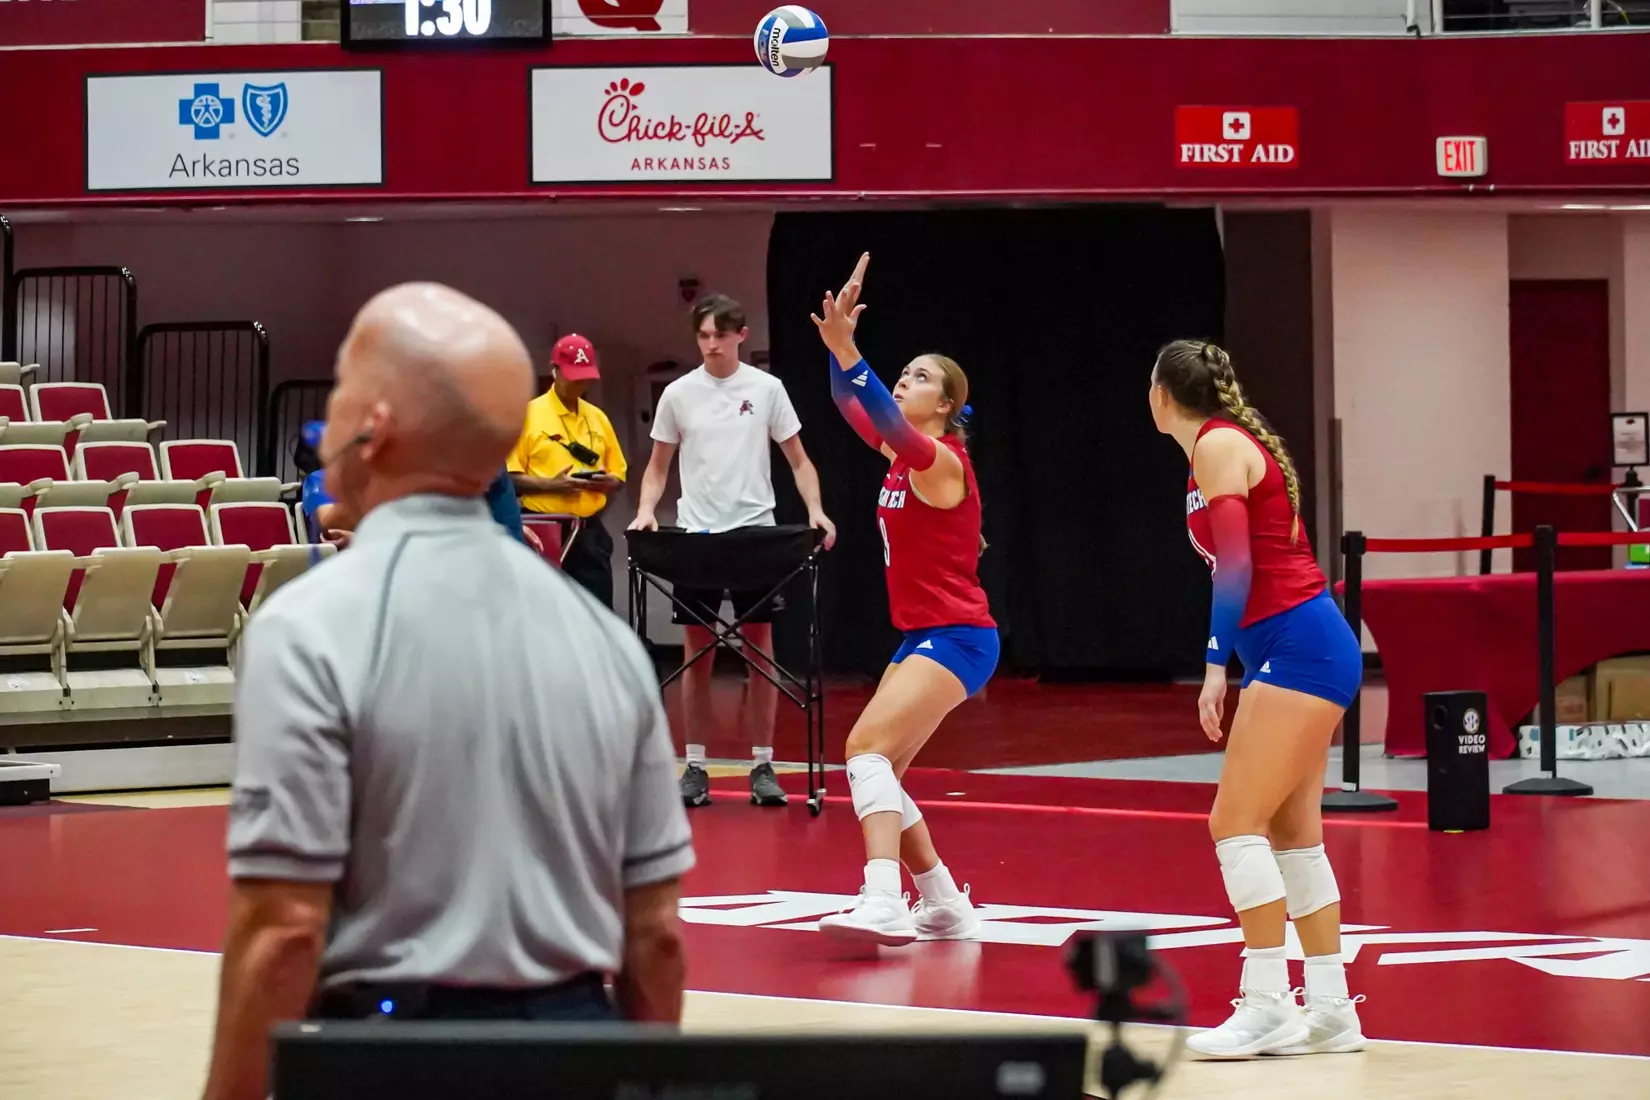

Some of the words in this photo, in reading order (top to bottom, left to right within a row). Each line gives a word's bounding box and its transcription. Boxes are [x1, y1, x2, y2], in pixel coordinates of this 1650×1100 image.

[770, 27, 781, 67] molten
[598, 94, 765, 147] Chick-fil-A
[1180, 144, 1244, 163] FIRST
[1250, 144, 1295, 163] AID
[1444, 141, 1476, 172] EXIT
[1569, 140, 1620, 159] FIRST
[169, 153, 300, 178] Arkansas
[631, 157, 731, 171] ARKANSAS
[1458, 734, 1486, 745] VIDEO
[1458, 745, 1486, 754] REVIEW
